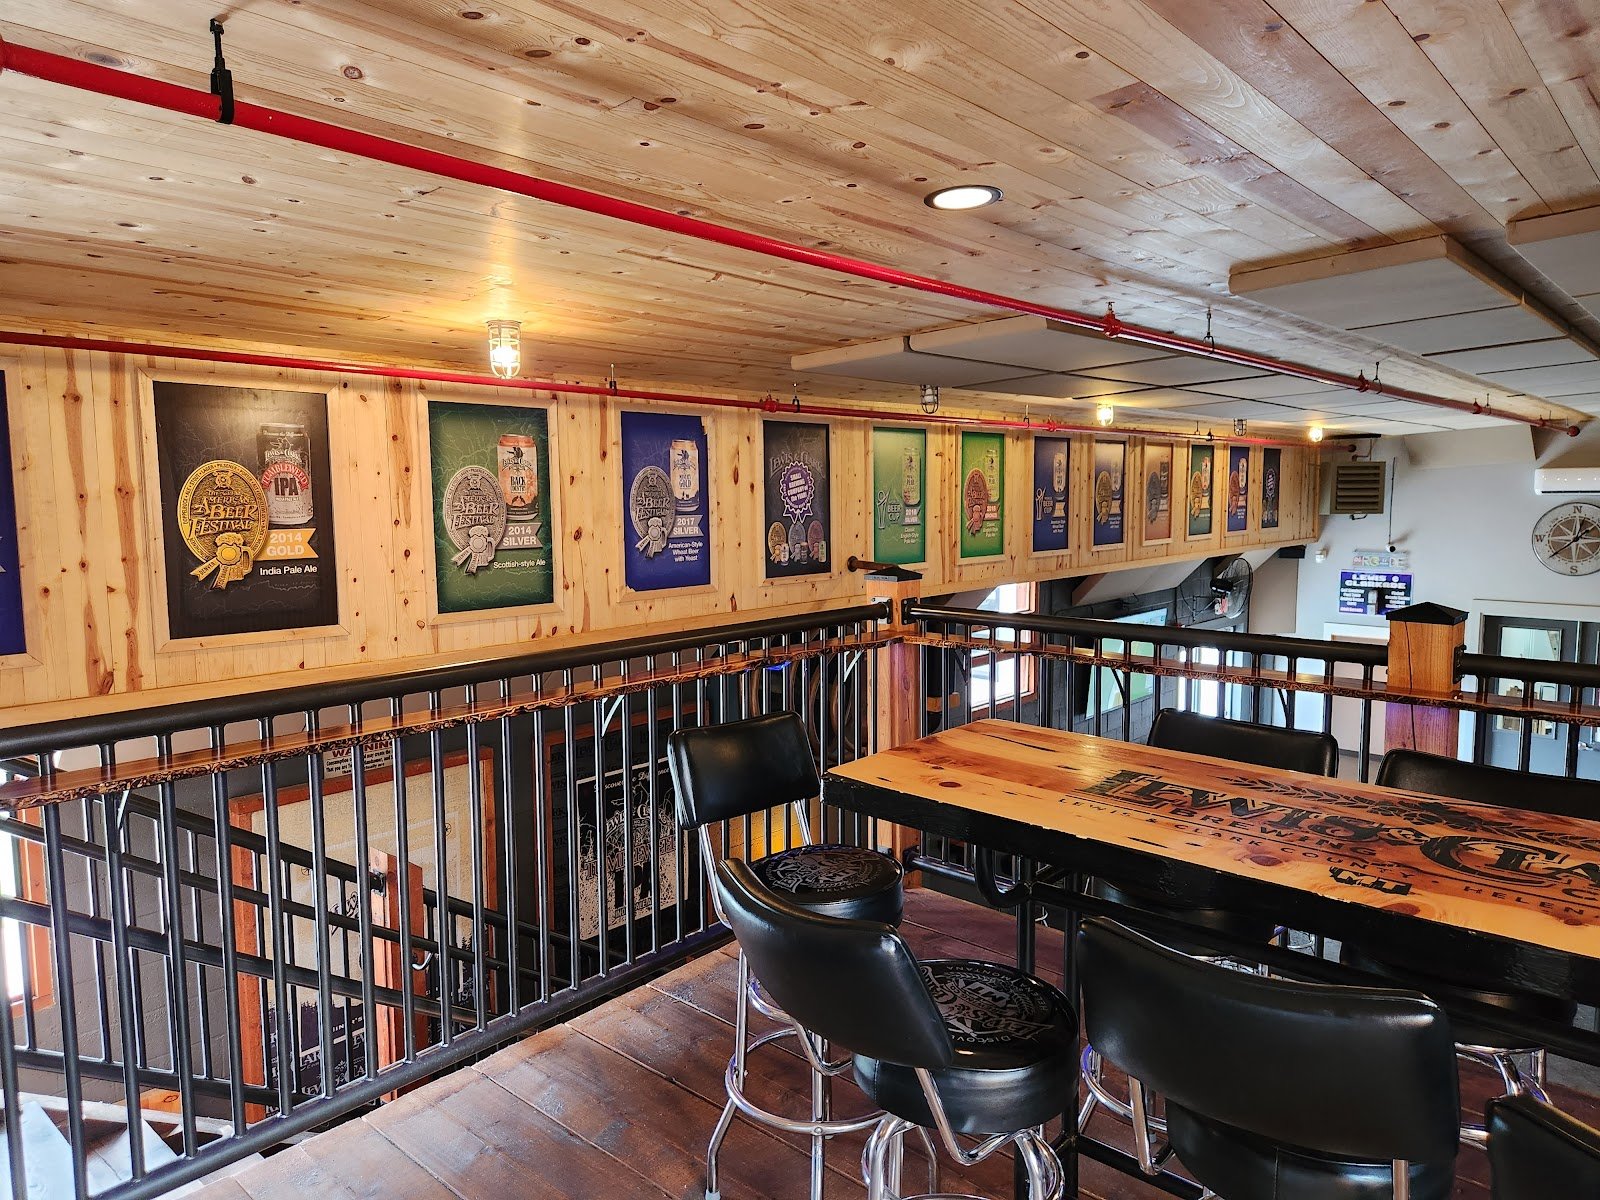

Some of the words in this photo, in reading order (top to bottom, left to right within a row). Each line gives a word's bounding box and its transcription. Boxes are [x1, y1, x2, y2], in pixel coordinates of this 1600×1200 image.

[261, 461, 310, 490] TUMBLEWEED
[273, 478, 299, 496] IPA
[209, 503, 259, 521] BEER
[1573, 505, 1583, 514] N
[451, 514, 497, 530] FESTIVAL
[677, 518, 695, 526] 2017
[188, 517, 252, 540] FESTIVAL
[508, 526, 532, 536] 2014
[672, 526, 699, 535] SILVER
[269, 533, 303, 544] 2014
[502, 536, 537, 547] SILVER
[1534, 534, 1546, 543] W
[668, 541, 703, 549] American-Style
[266, 546, 305, 557] GOLD
[672, 548, 688, 556] Wheat
[688, 547, 699, 555] Beer
[685, 554, 698, 562] Yeast
[493, 560, 535, 569] Scottish-style
[535, 559, 546, 567] Ale
[1569, 565, 1578, 574] S
[260, 567, 282, 576] India
[284, 565, 303, 575] Pale
[304, 564, 318, 574] Ale
[1351, 574, 1387, 582] LEWIS
[332, 739, 393, 758] WANIN
[1075, 769, 1384, 842] LEWIS
[1170, 806, 1377, 857] BREWING
[1058, 798, 1132, 818] LEWIS
[1145, 817, 1158, 825] &
[1174, 823, 1262, 847] CLARK
[1280, 847, 1413, 879] COUNTY
[1463, 885, 1600, 919] HELEN
[1331, 866, 1413, 896] MT
[946, 966, 1011, 982] MONTANA
[950, 1034, 1011, 1043] DISCOV
